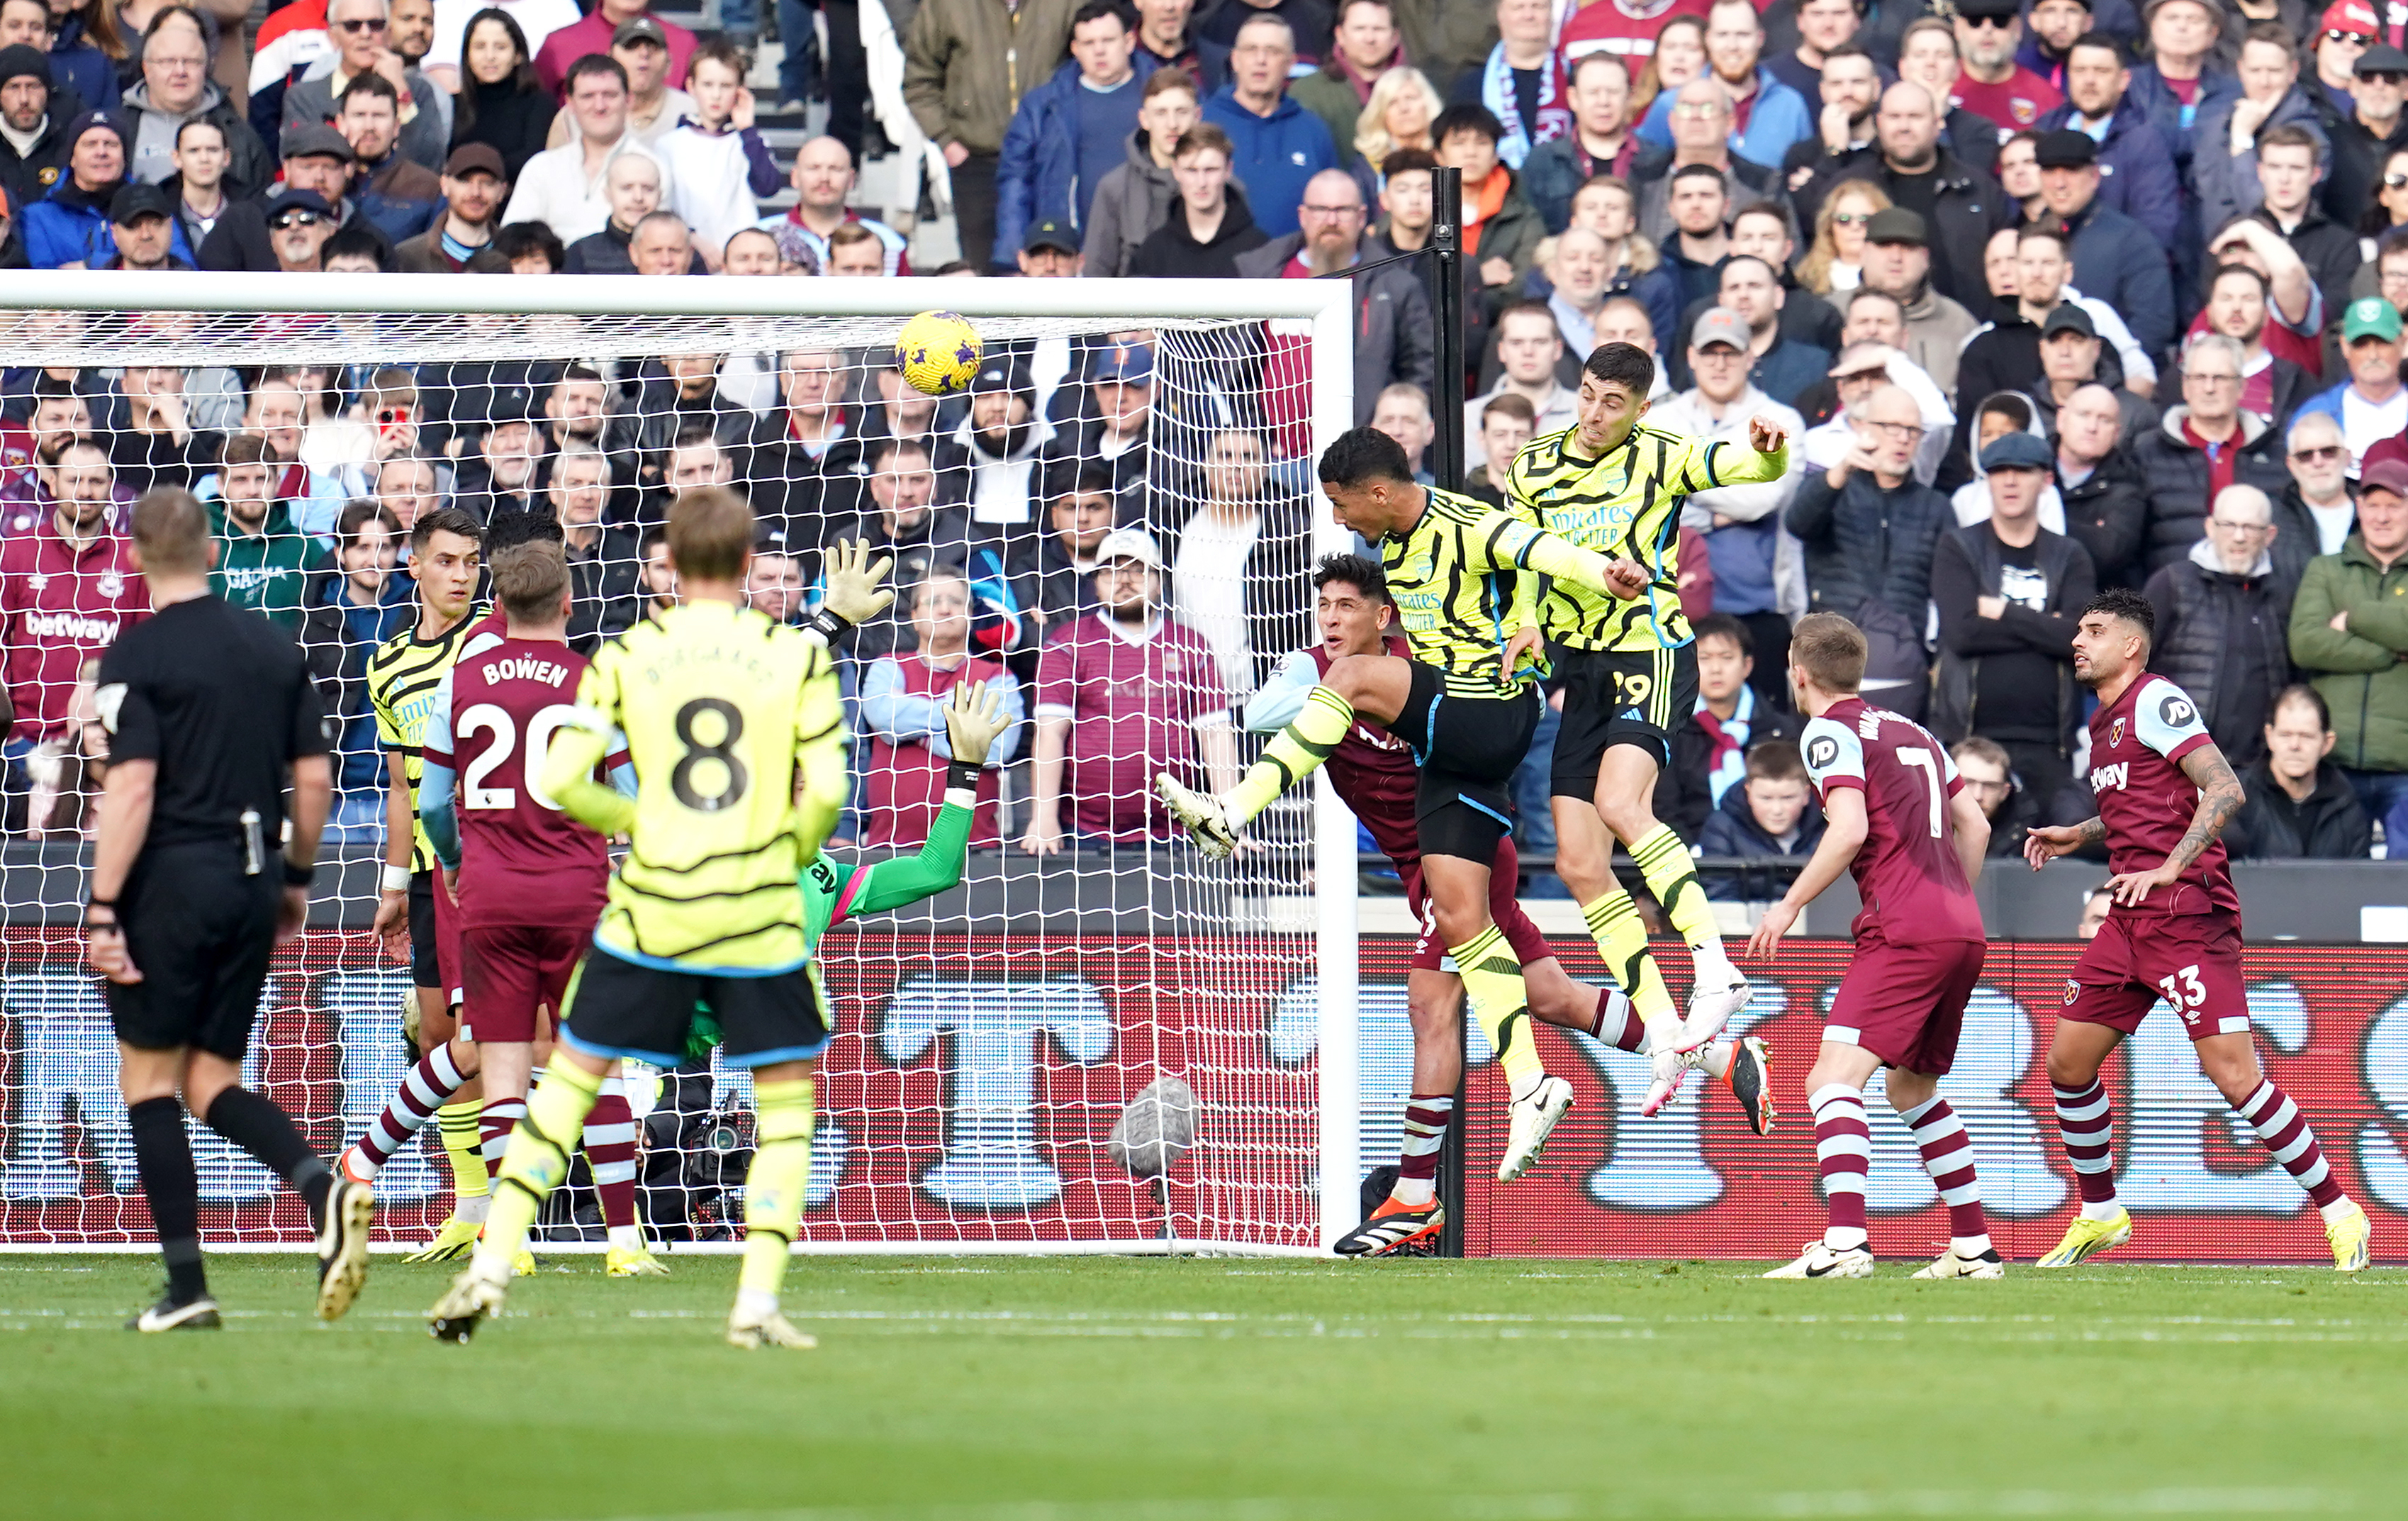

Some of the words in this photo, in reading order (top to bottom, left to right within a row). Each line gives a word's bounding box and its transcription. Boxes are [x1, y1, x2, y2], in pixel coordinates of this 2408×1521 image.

[1573, 528, 1618, 547] BETTER
[25, 611, 118, 645] betway
[482, 659, 568, 689] BOWEN
[2168, 701, 2191, 725] JD
[457, 703, 595, 810] 20
[672, 697, 748, 811] 8
[1812, 740, 1835, 768] JD
[1896, 747, 1942, 839] 7
[2158, 964, 2207, 1013] 33
